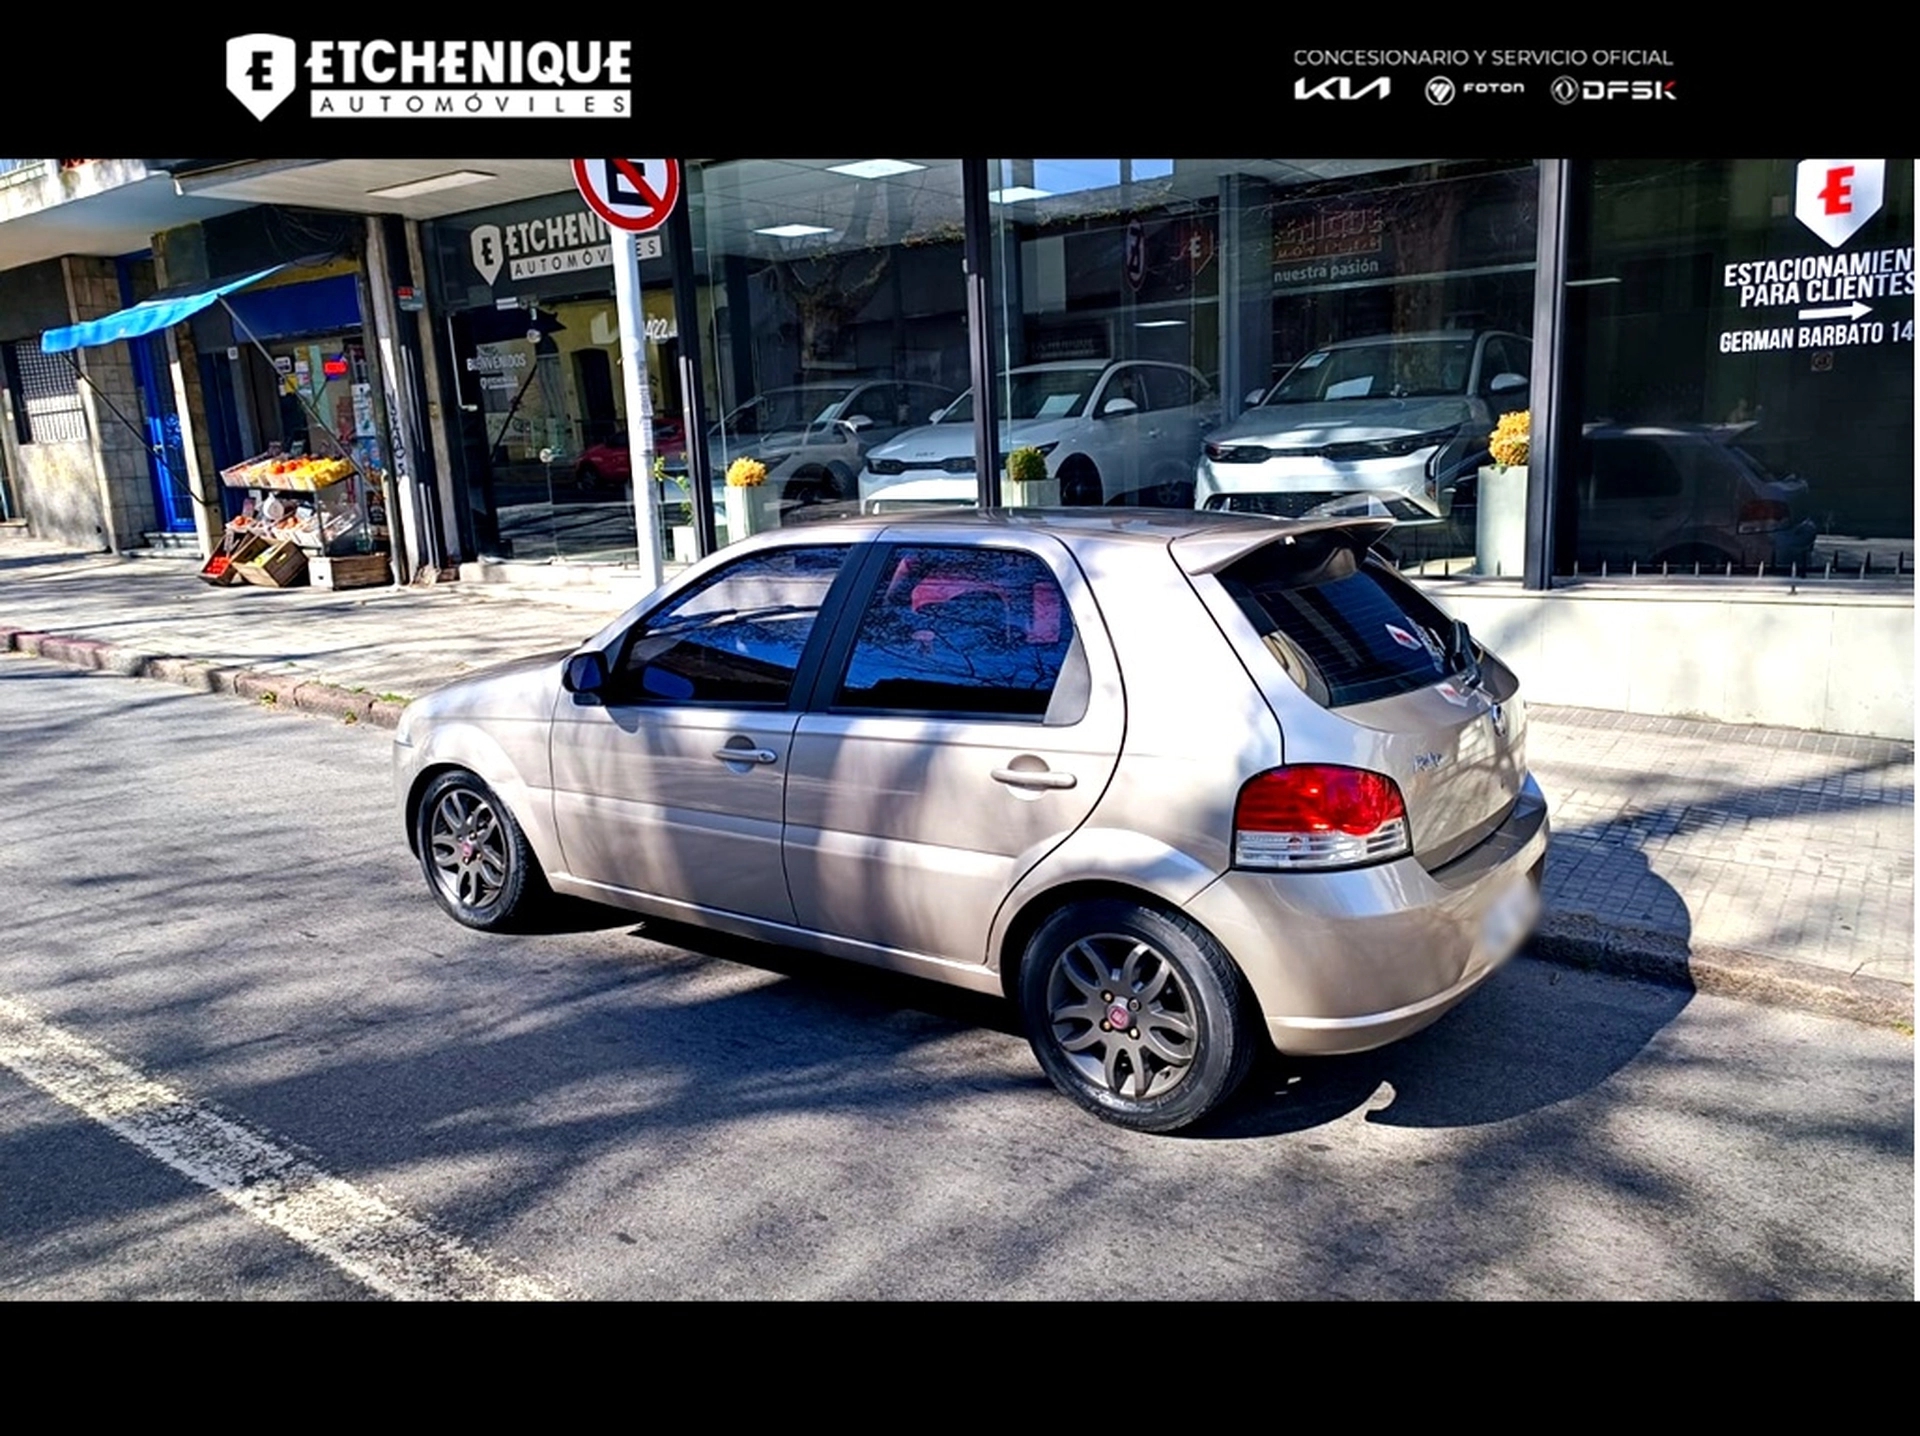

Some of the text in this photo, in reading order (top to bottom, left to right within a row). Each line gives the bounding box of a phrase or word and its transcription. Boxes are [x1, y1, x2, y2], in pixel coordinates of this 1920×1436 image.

[1817, 166, 1855, 216] E
[505, 210, 611, 256] ETCHENI
[514, 240, 656, 277] AUTOMÓVES
[1274, 258, 1379, 283] nuestra pasión
[1724, 247, 1914, 287] ESTACIONAMIEN
[1740, 271, 1914, 308] PARA CLIENTES
[1719, 328, 1794, 353] GERMAN
[1797, 321, 1884, 348] BARBATO
